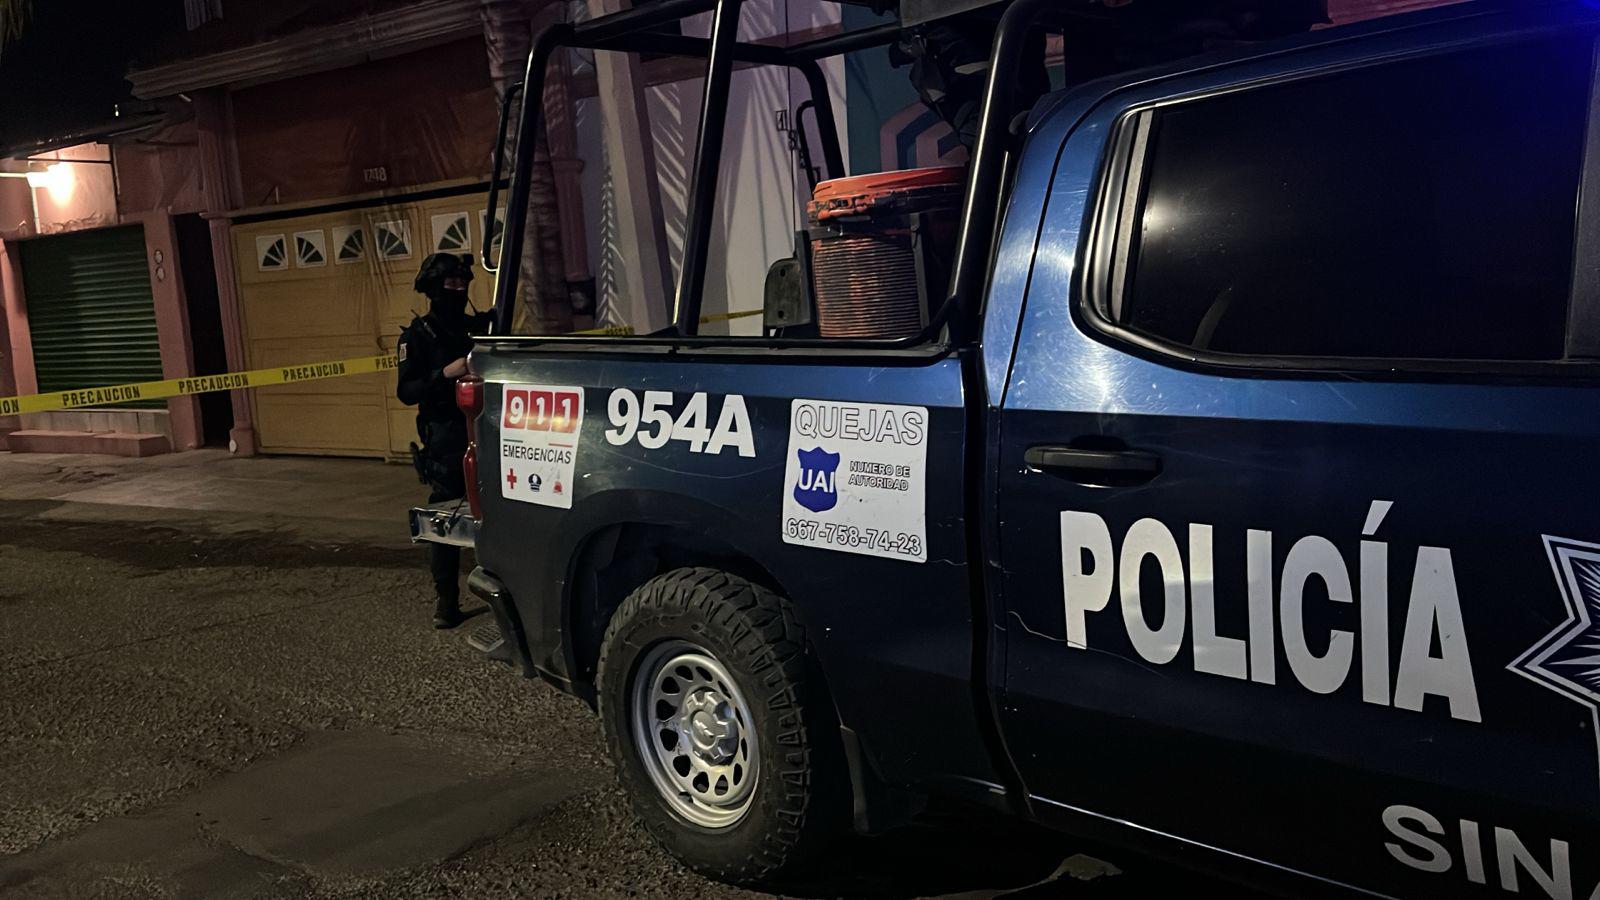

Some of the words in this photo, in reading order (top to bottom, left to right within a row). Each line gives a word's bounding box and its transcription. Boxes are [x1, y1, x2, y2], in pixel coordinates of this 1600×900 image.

[62, 386, 140, 406] PRECAUCION
[178, 374, 249, 394] PRECAUCION
[282, 362, 346, 381] PRECAUCION
[509, 395, 572, 427] 911
[605, 388, 756, 457] 954A
[795, 404, 923, 446] QUEJAS
[503, 444, 572, 464] EMERGENCIAS
[850, 460, 894, 476] NUMERO
[895, 465, 910, 478] DE
[799, 468, 835, 493] UAI
[848, 474, 909, 491] AUTORIDAD
[787, 518, 921, 556] 667-758-74-23
[1060, 499, 1482, 723] POLICÍA
[1381, 804, 1600, 900] SIN
